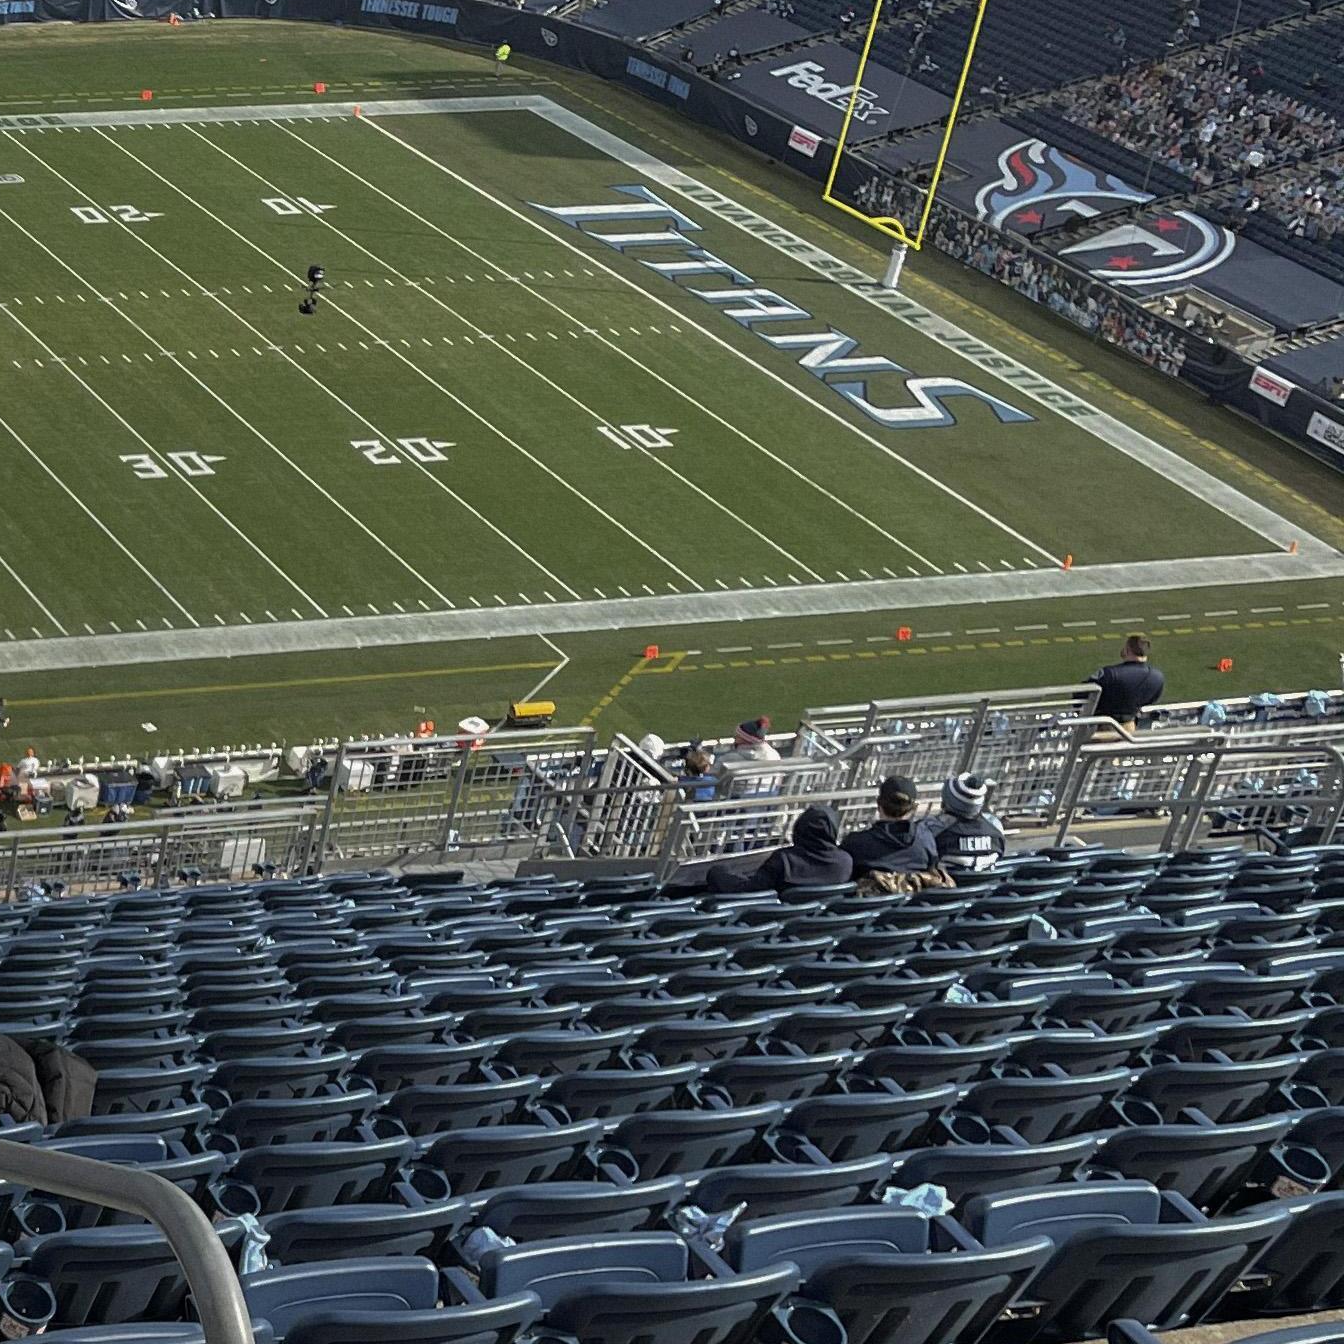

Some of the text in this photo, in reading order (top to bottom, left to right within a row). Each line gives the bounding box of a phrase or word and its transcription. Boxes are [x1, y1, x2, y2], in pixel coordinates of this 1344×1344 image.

[421, 4, 459, 25] TOUGH
[769, 60, 890, 121] FedEx
[69, 204, 150, 224] 20
[260, 196, 324, 215] 10
[524, 183, 1037, 429] TITANS
[674, 183, 1099, 420] ADVANCE SOCIAL JUSTICE
[1253, 373, 1288, 400] ESPN
[596, 424, 674, 450] 10
[350, 437, 449, 465] 20
[119, 451, 216, 479] 30
